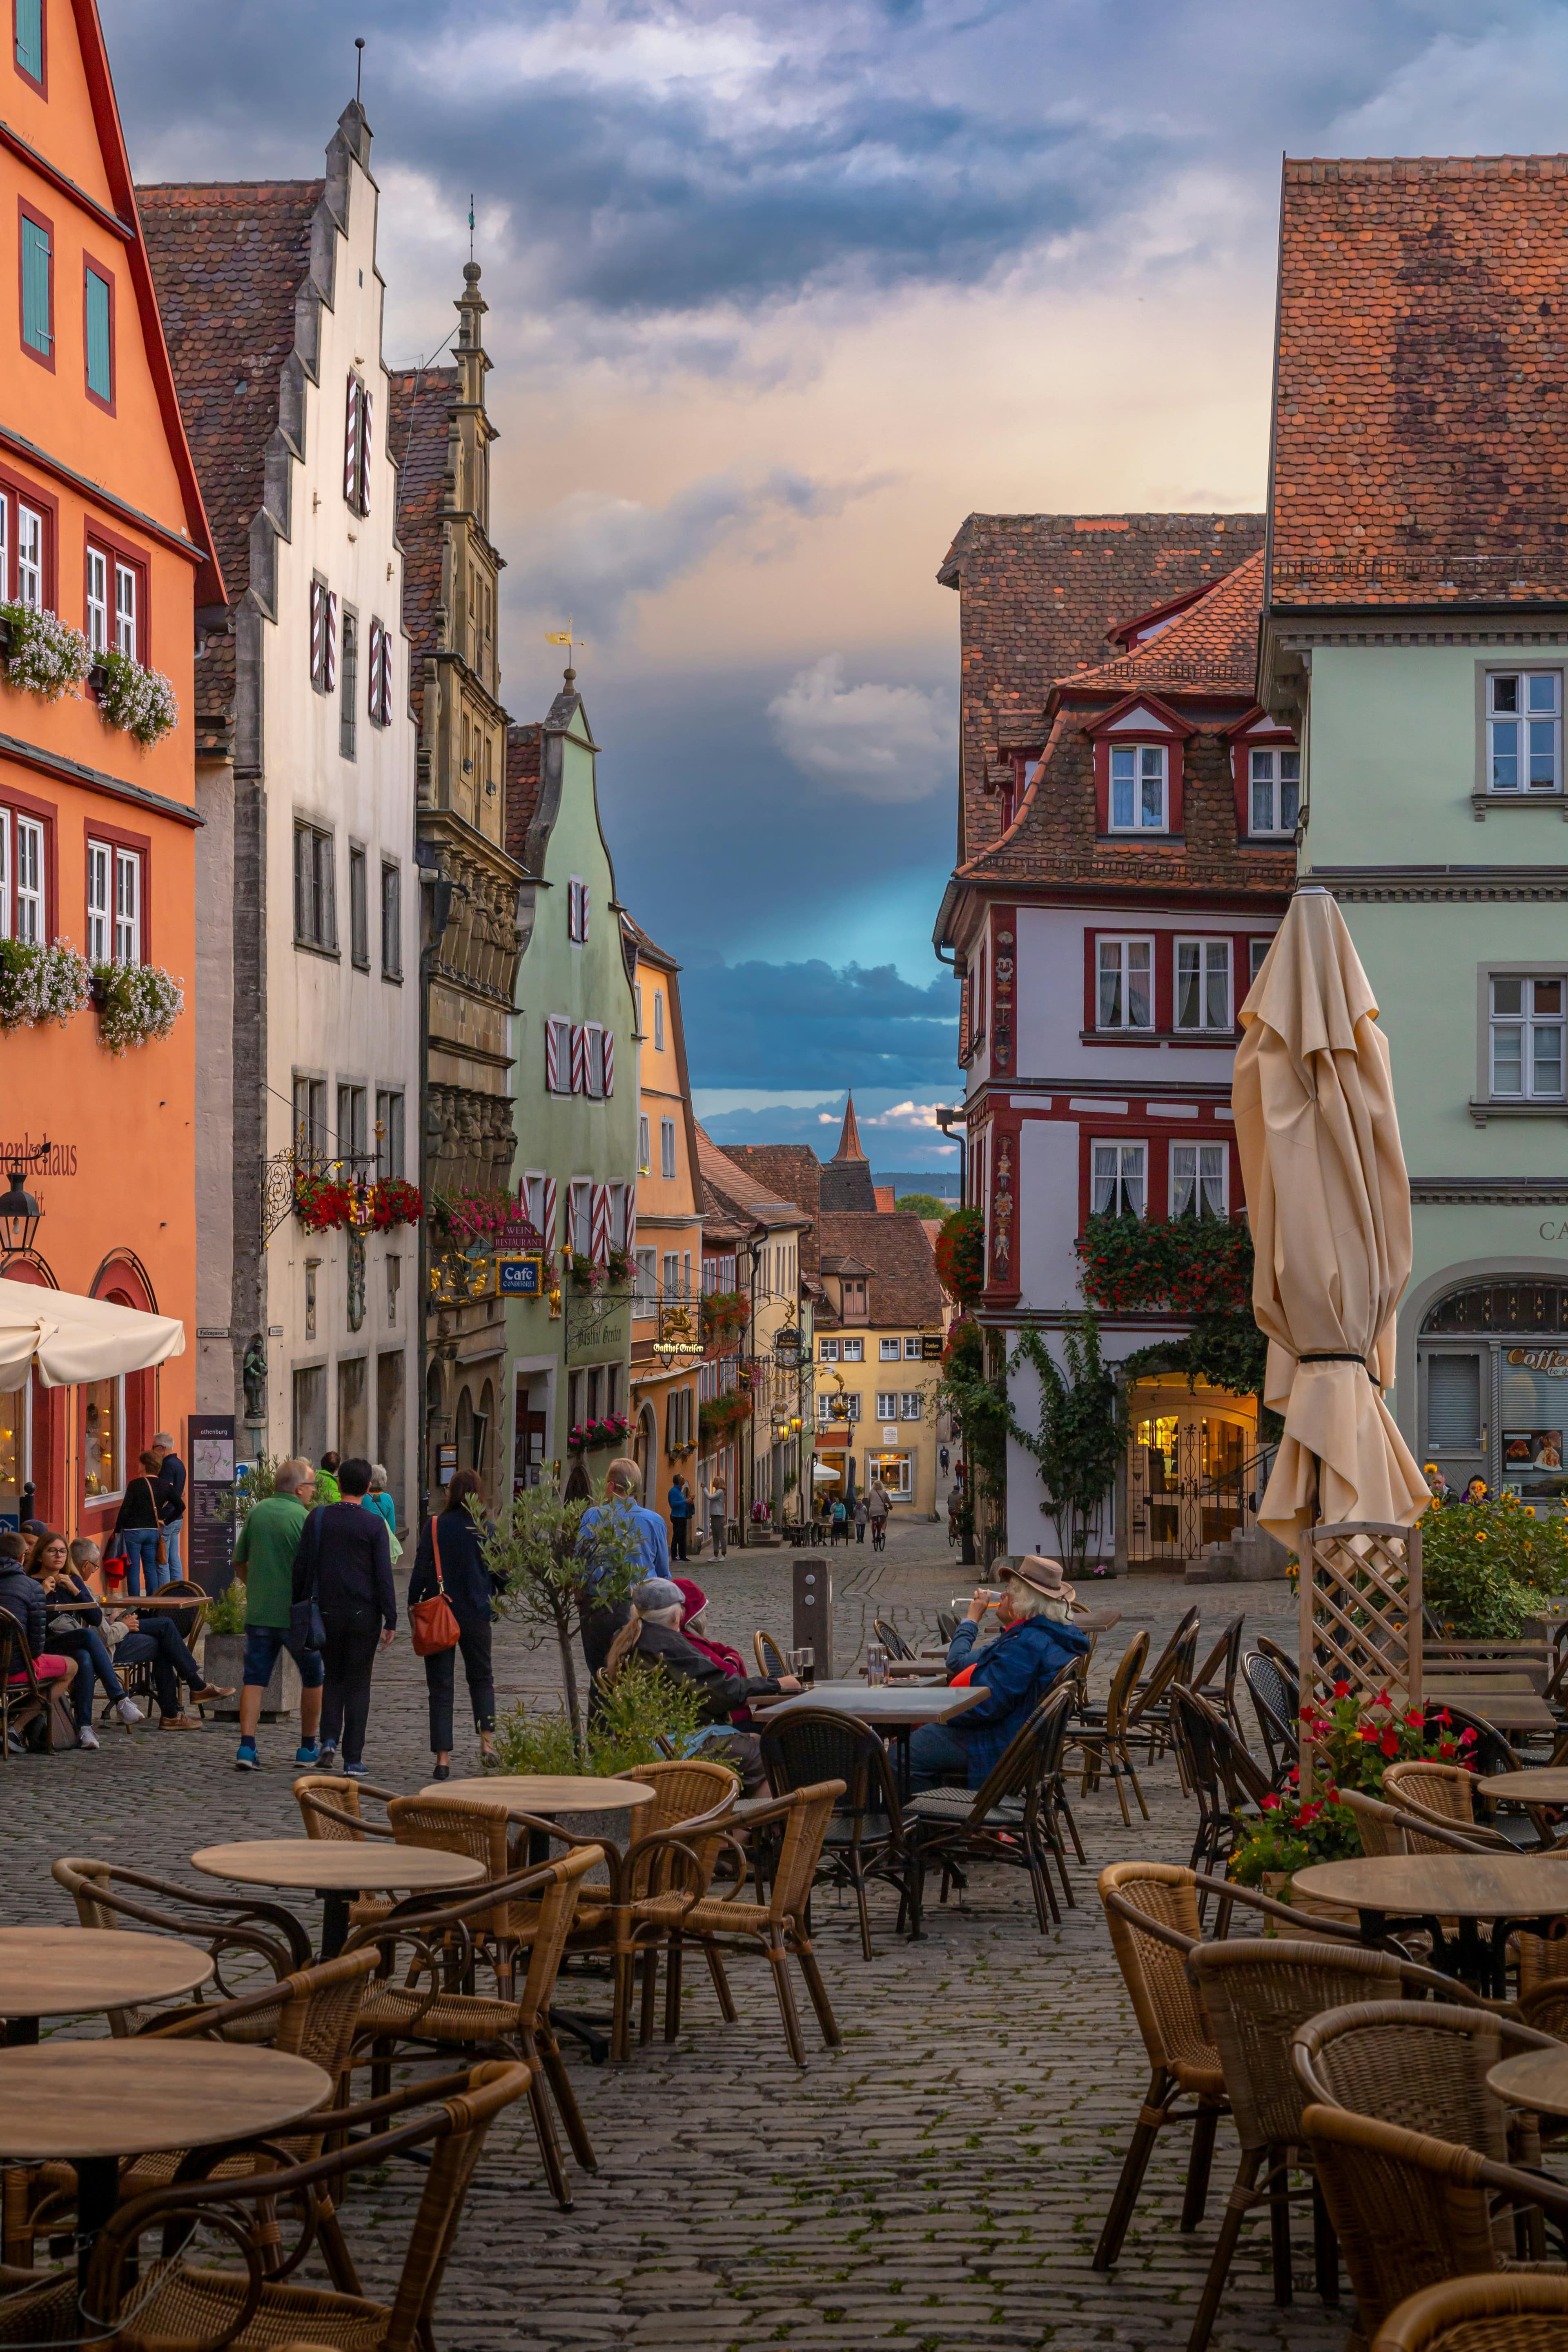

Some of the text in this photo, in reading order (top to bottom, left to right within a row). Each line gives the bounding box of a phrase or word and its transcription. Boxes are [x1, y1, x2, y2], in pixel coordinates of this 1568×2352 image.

[505, 1267, 533, 1280] Cafe
[603, 1325, 621, 1343] Greifen
[679, 1343, 704, 1353] Greifen
[1508, 1348, 1568, 1370] Coffe
